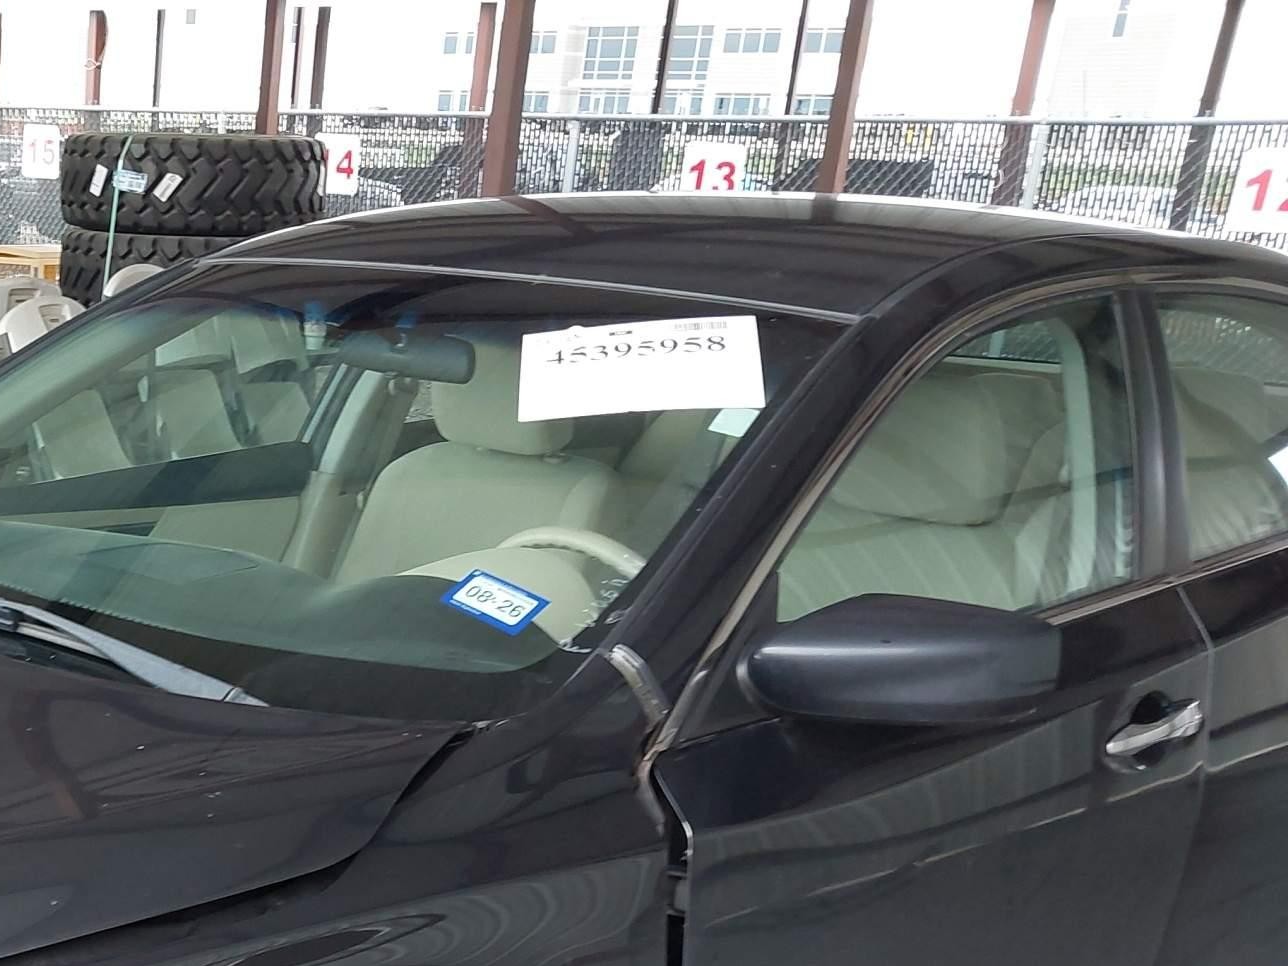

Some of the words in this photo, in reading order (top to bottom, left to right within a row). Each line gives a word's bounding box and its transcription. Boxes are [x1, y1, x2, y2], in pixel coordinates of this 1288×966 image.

[27, 138, 55, 165] 15
[688, 158, 736, 191] 13
[1245, 168, 1288, 212] 1
[546, 335, 727, 365] 45395958
